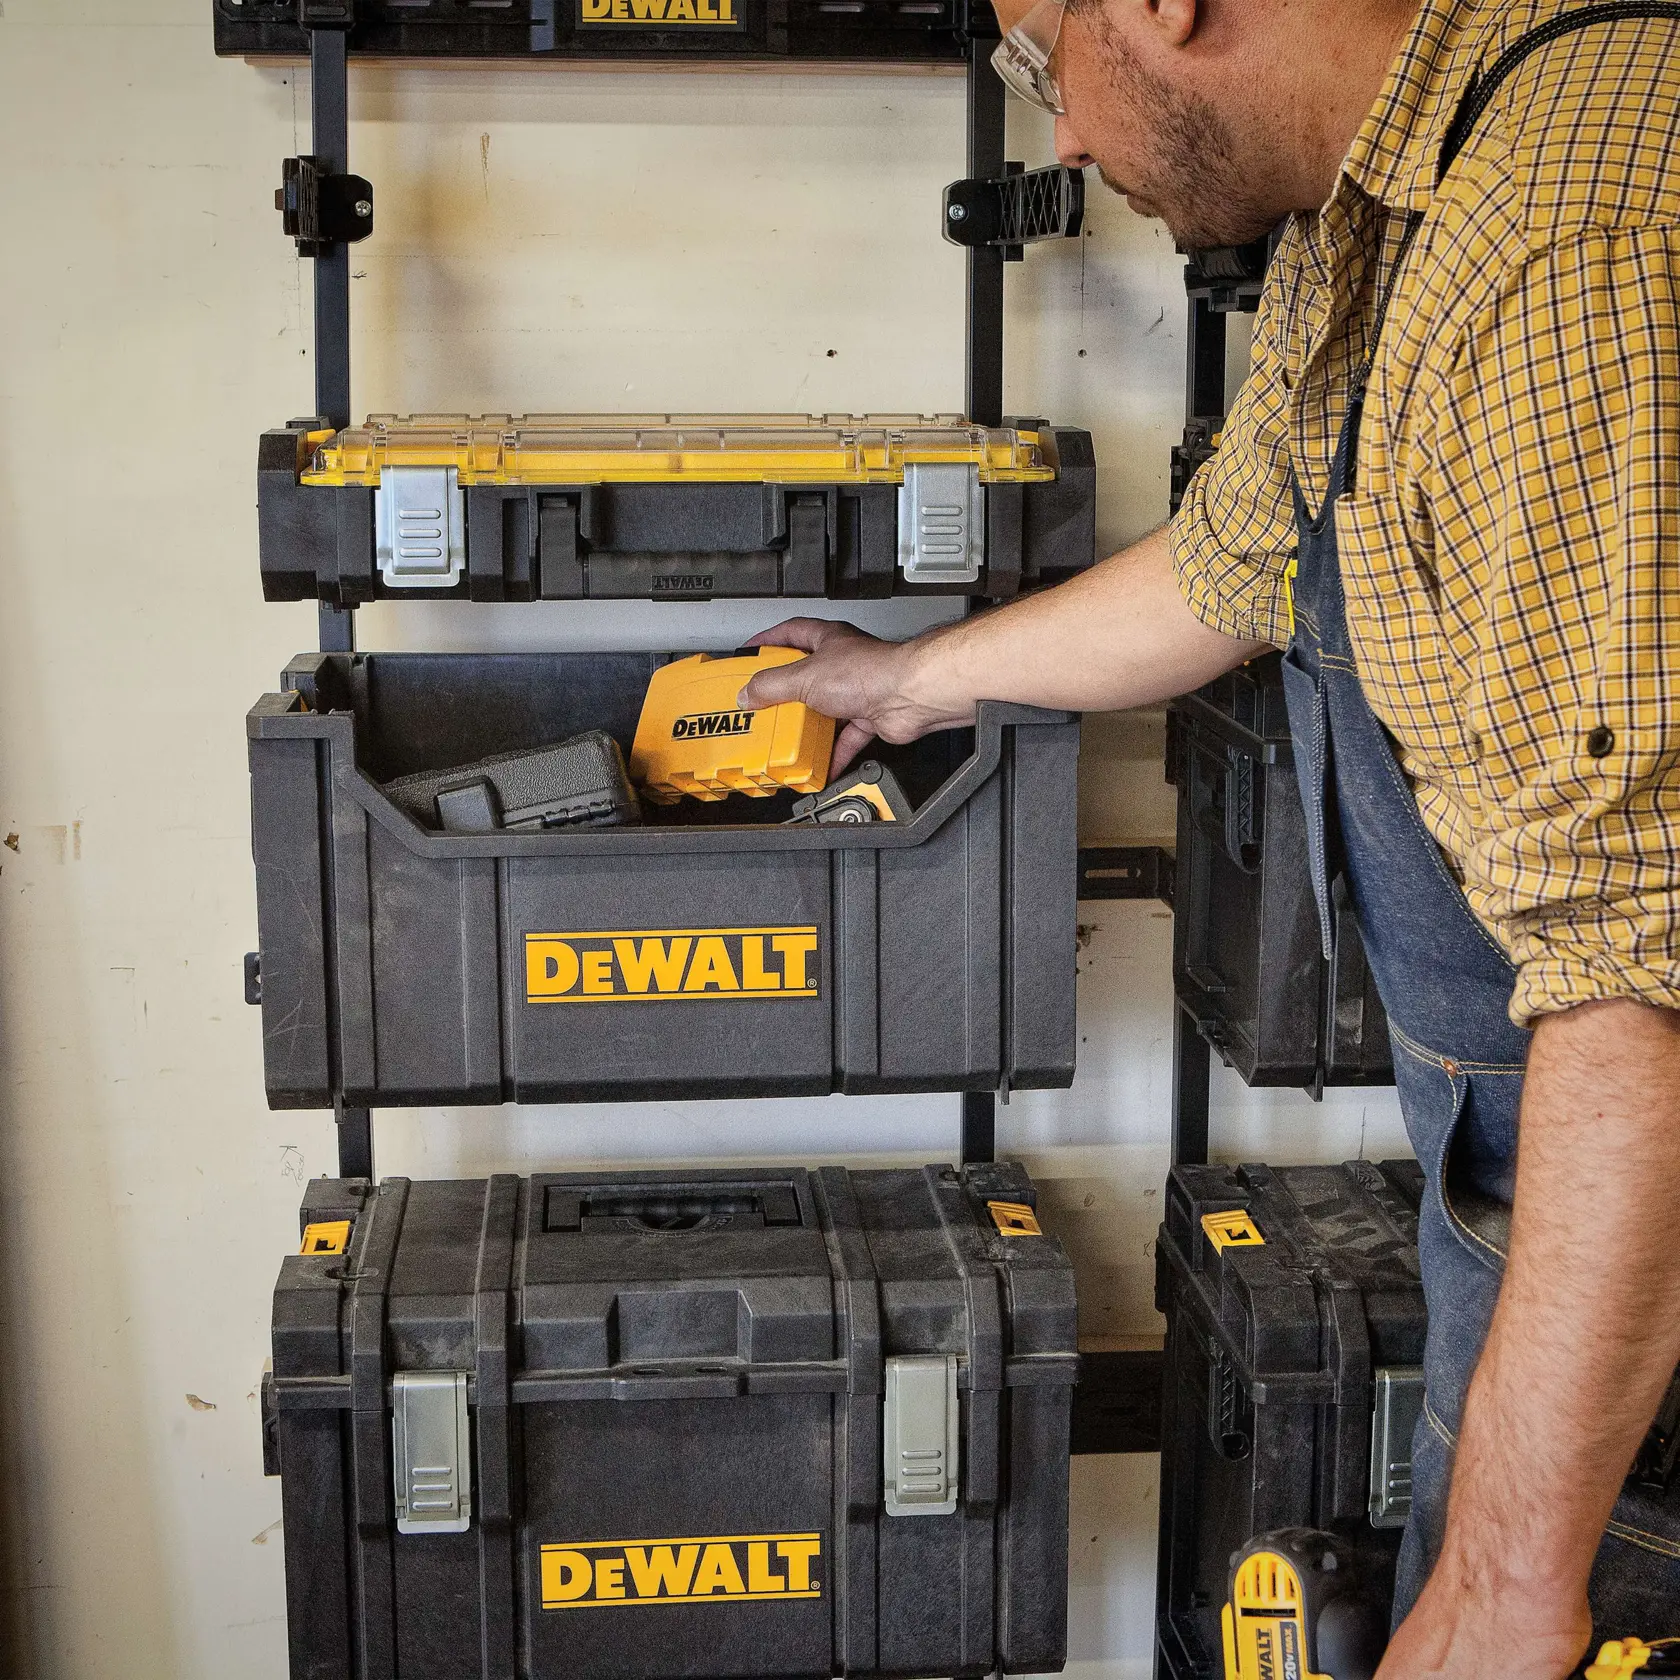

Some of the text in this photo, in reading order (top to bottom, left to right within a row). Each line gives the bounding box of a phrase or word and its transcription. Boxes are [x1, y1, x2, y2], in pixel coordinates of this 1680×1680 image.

[654, 577, 713, 589] DEWALT
[671, 711, 755, 738] DEWALT
[526, 934, 817, 995] DEWALT
[541, 1541, 820, 1602] DEWALT
